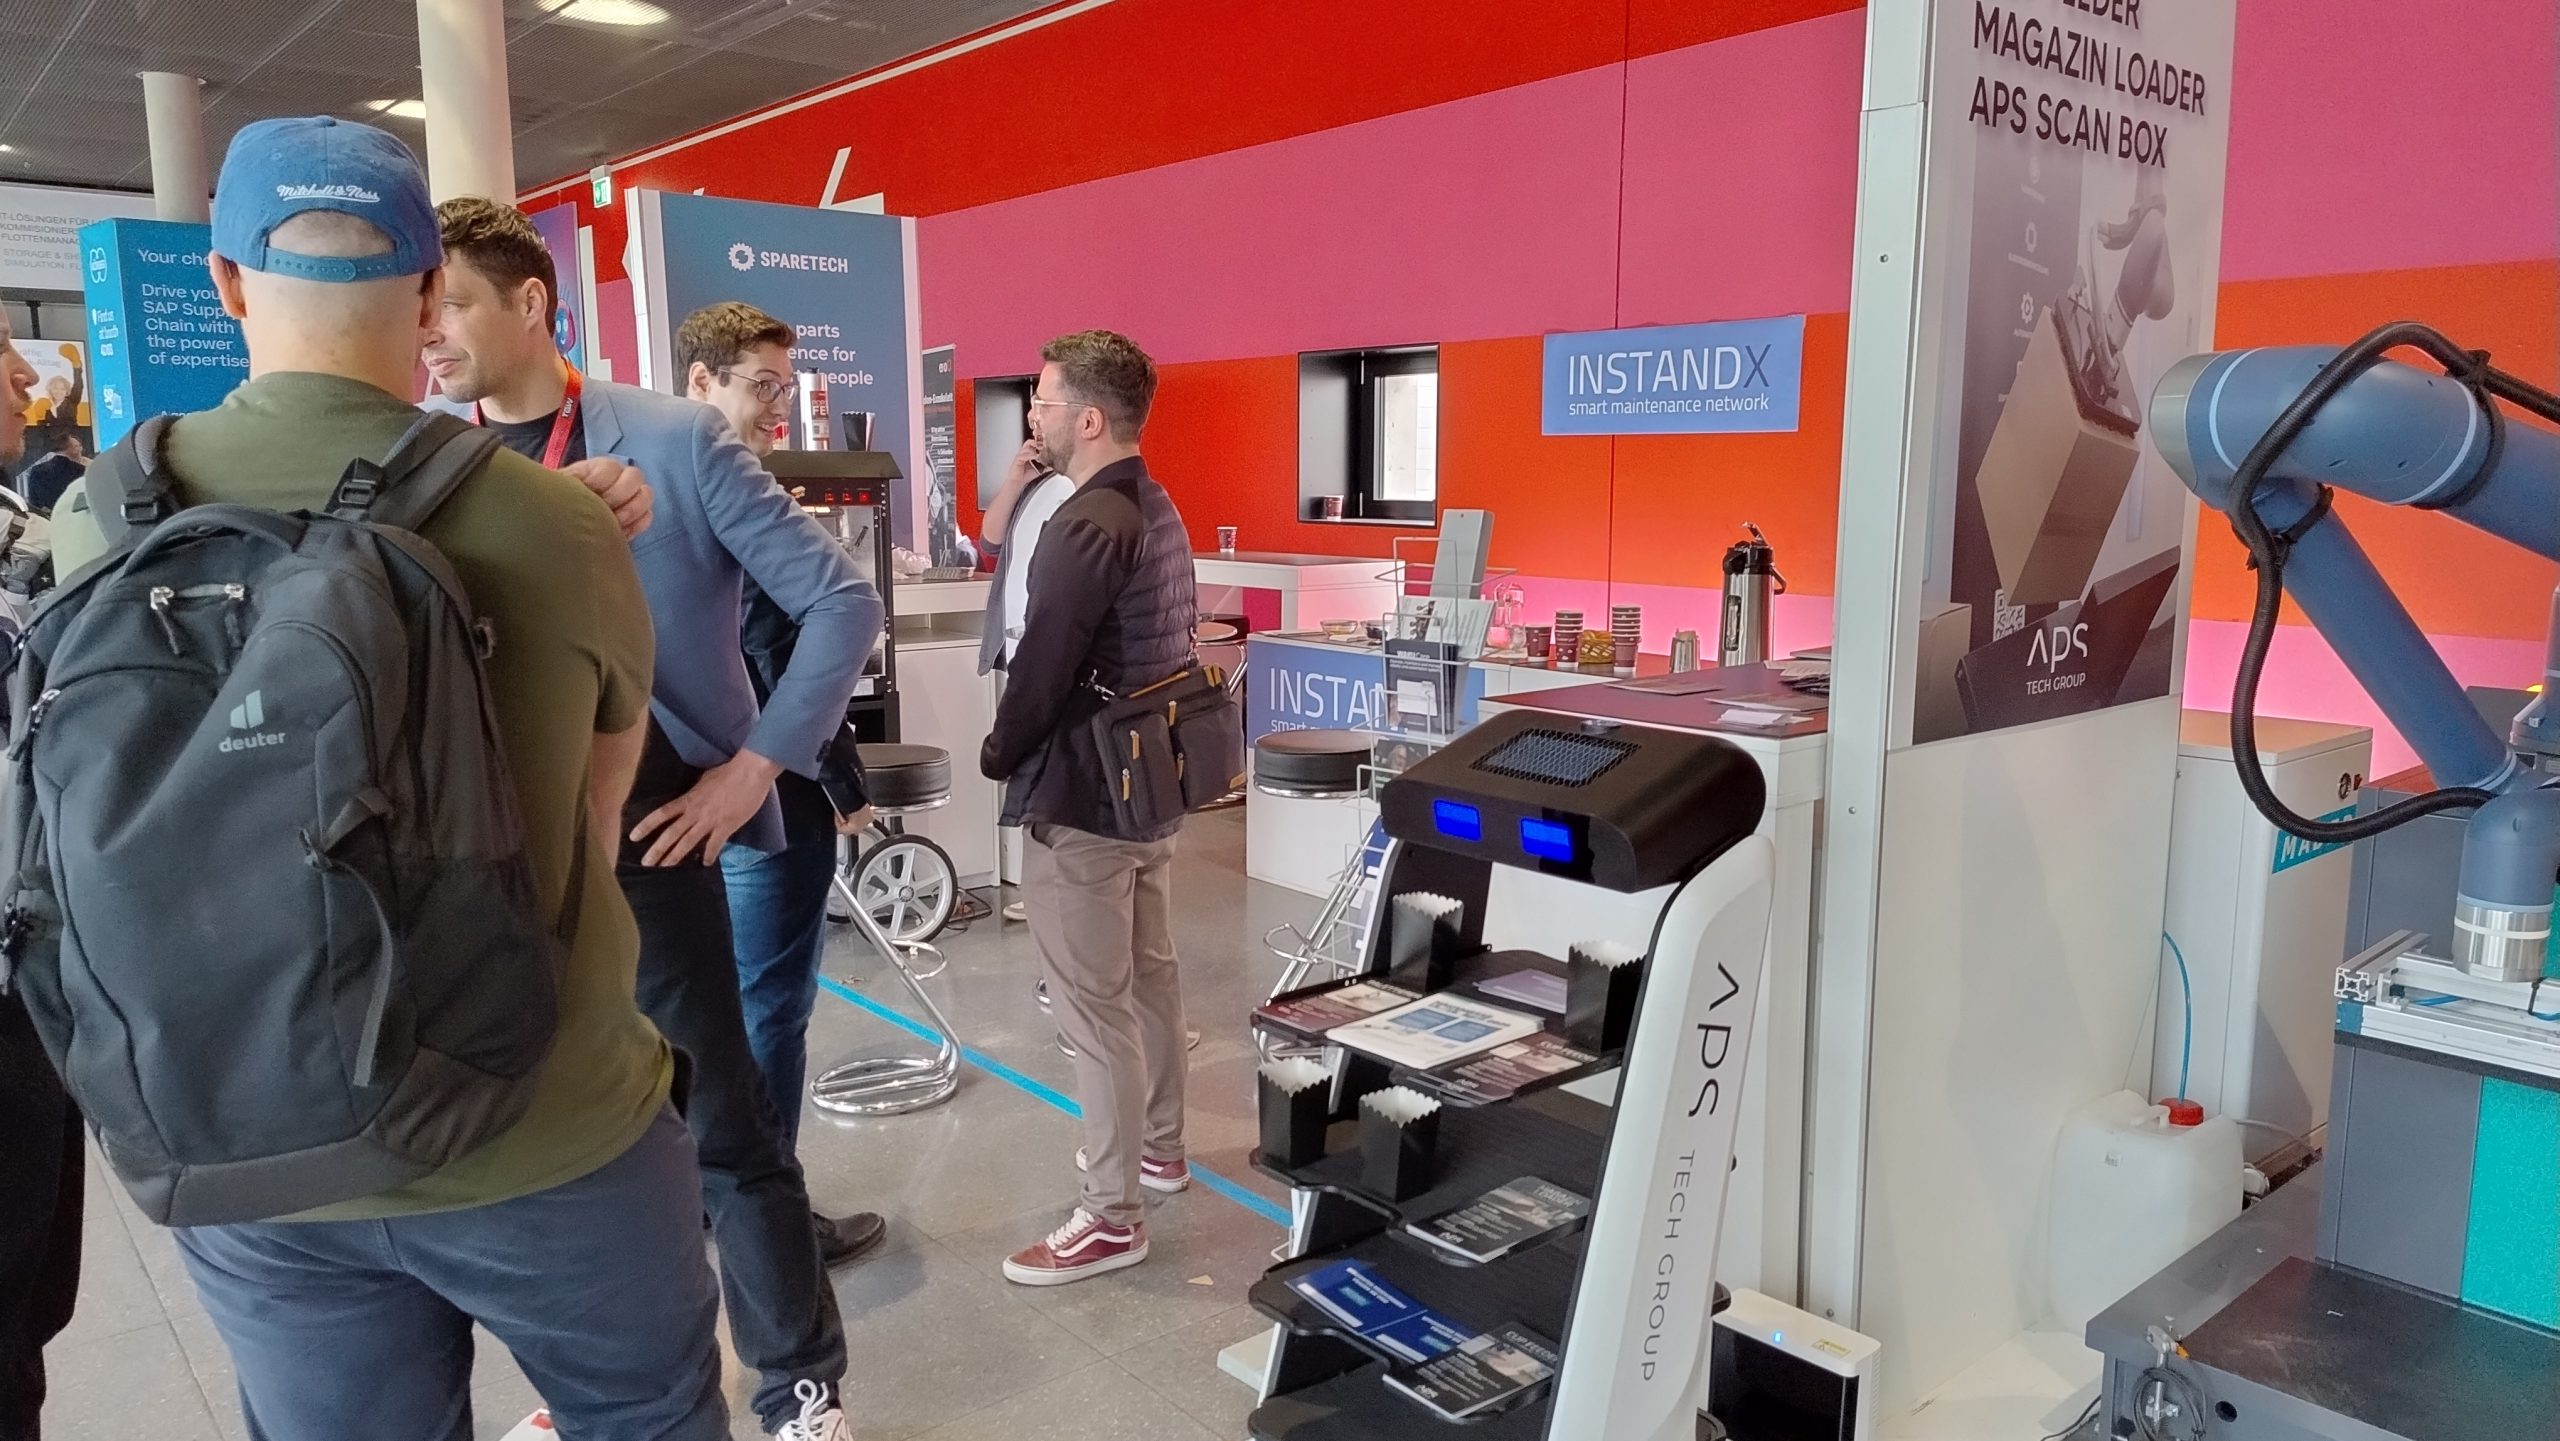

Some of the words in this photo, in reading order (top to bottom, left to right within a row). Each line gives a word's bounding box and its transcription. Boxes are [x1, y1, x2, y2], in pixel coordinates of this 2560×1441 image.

[1973, 0, 2107, 86] MAGAZIN
[2114, 47, 2205, 116] LOADER
[1968, 76, 2027, 134] APS
[2035, 93, 2111, 154] SCAN
[2118, 115, 2168, 169] BOX
[277, 183, 334, 197] Mitchell
[334, 185, 347, 196] &
[346, 185, 380, 200] Ness
[138, 249, 177, 264] Your
[760, 251, 849, 273] SPARETECH
[142, 283, 187, 298] Drive
[191, 288, 221, 302] you
[143, 301, 178, 315] SAP
[183, 303, 234, 319] Supp
[145, 318, 195, 333] Chain
[198, 320, 235, 335] with
[796, 323, 840, 339] parts
[146, 334, 177, 348] the
[180, 338, 233, 351] power
[148, 351, 167, 365] of
[170, 354, 250, 368] expertise
[787, 347, 829, 360] ence
[832, 346, 856, 361] for
[820, 370, 874, 388] eople
[1568, 343, 1772, 395] INSTANDX
[1569, 399, 1608, 416] smart
[1611, 397, 1701, 414] maintenance
[1705, 393, 1769, 412] network
[2026, 623, 2089, 674] APS
[2026, 678, 2052, 695] TECH
[2053, 672, 2086, 691] GROUP
[219, 732, 286, 753] deuter
[1687, 961, 1740, 1118] APS
[1664, 1148, 1696, 1240] TECH
[1640, 1253, 1675, 1382] GROUP
